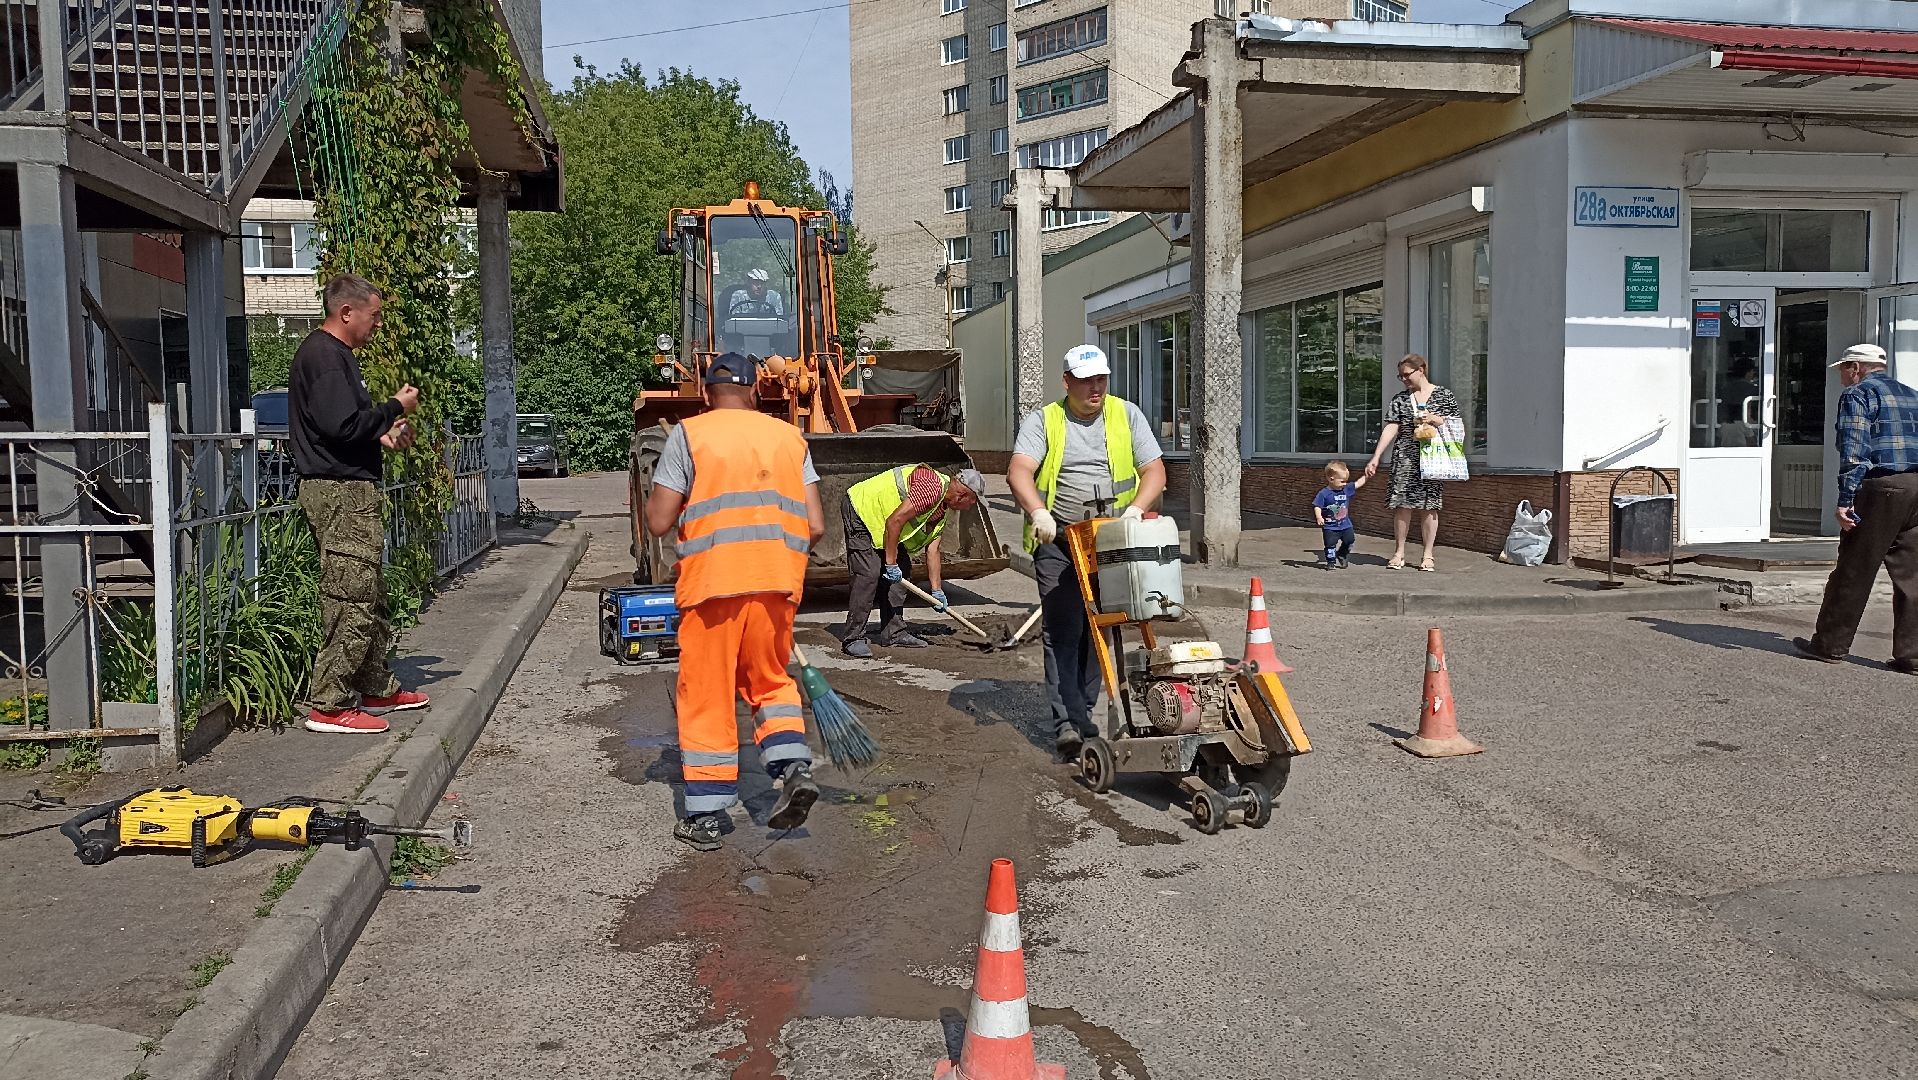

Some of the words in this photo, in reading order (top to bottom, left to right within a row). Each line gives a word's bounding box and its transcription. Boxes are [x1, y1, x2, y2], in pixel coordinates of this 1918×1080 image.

[1579, 191, 1606, 221] 28а
[1632, 196, 1655, 204] улица
[1609, 205, 1675, 218] ОКТЯБРЬСКАЯ
